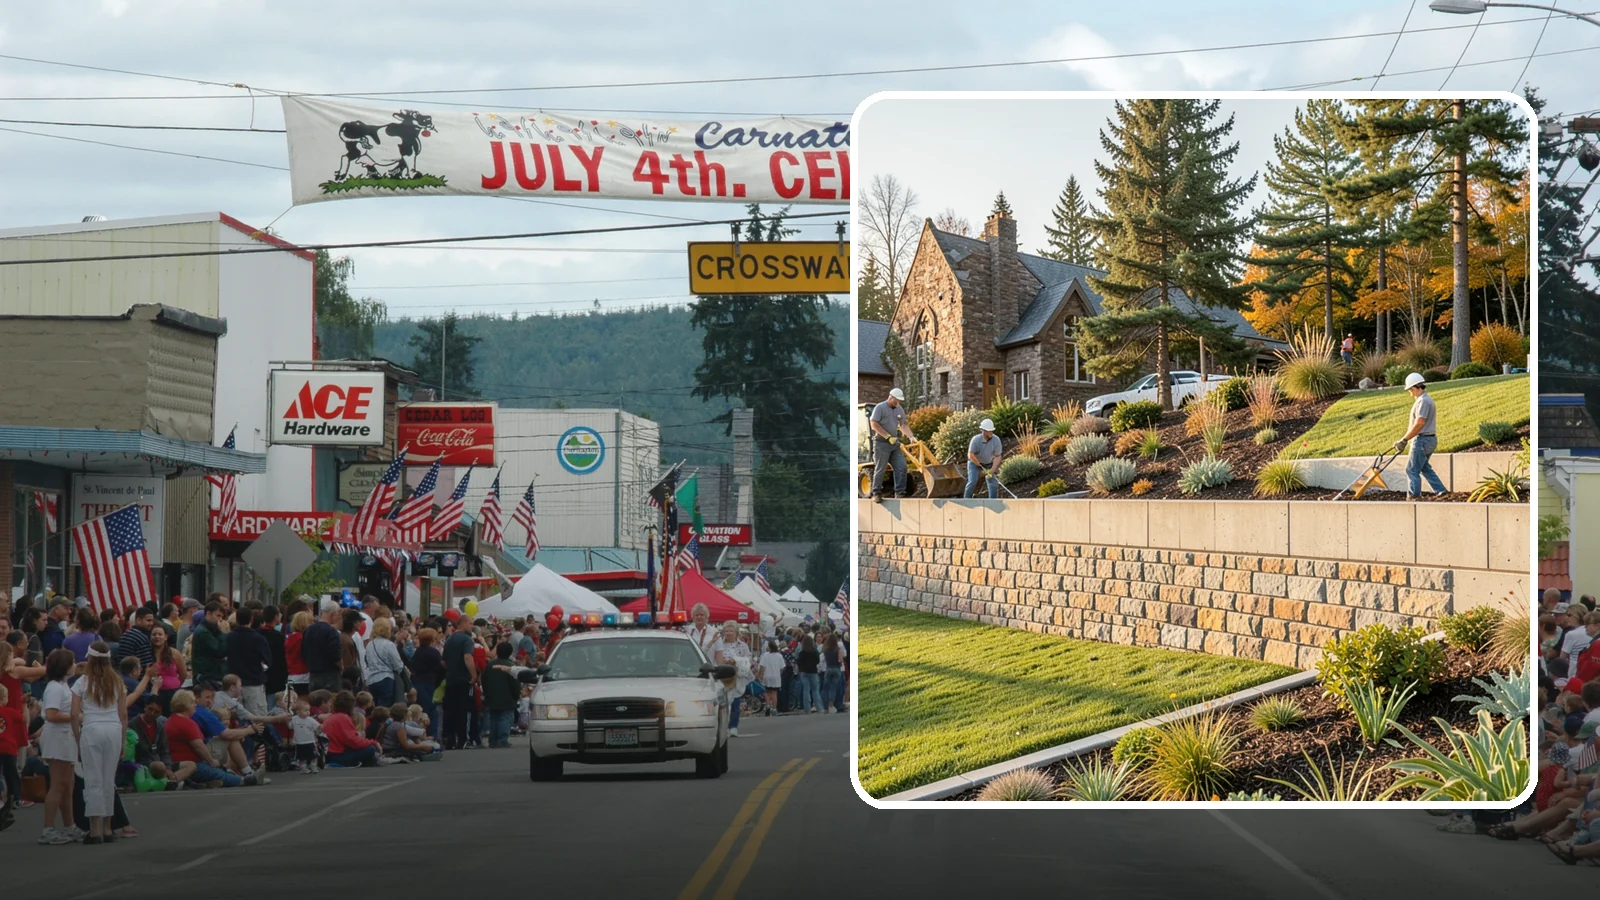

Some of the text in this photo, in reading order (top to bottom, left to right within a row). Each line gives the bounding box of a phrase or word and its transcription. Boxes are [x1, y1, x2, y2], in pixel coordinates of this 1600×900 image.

[481, 140, 605, 193] JULY
[632, 150, 746, 198] 4th.
[697, 254, 850, 280] CROSSWA
[282, 380, 374, 420] ACE
[405, 409, 453, 422] CEDAR
[283, 421, 371, 437] Hardware
[416, 428, 478, 447] Coca-Cola
[353, 467, 386, 480] Simpl
[95, 485, 124, 495] Vincent
[126, 485, 136, 495] de
[137, 486, 155, 495] Paul
[688, 526, 742, 535] CRNATION
[699, 535, 730, 544] GLASS
